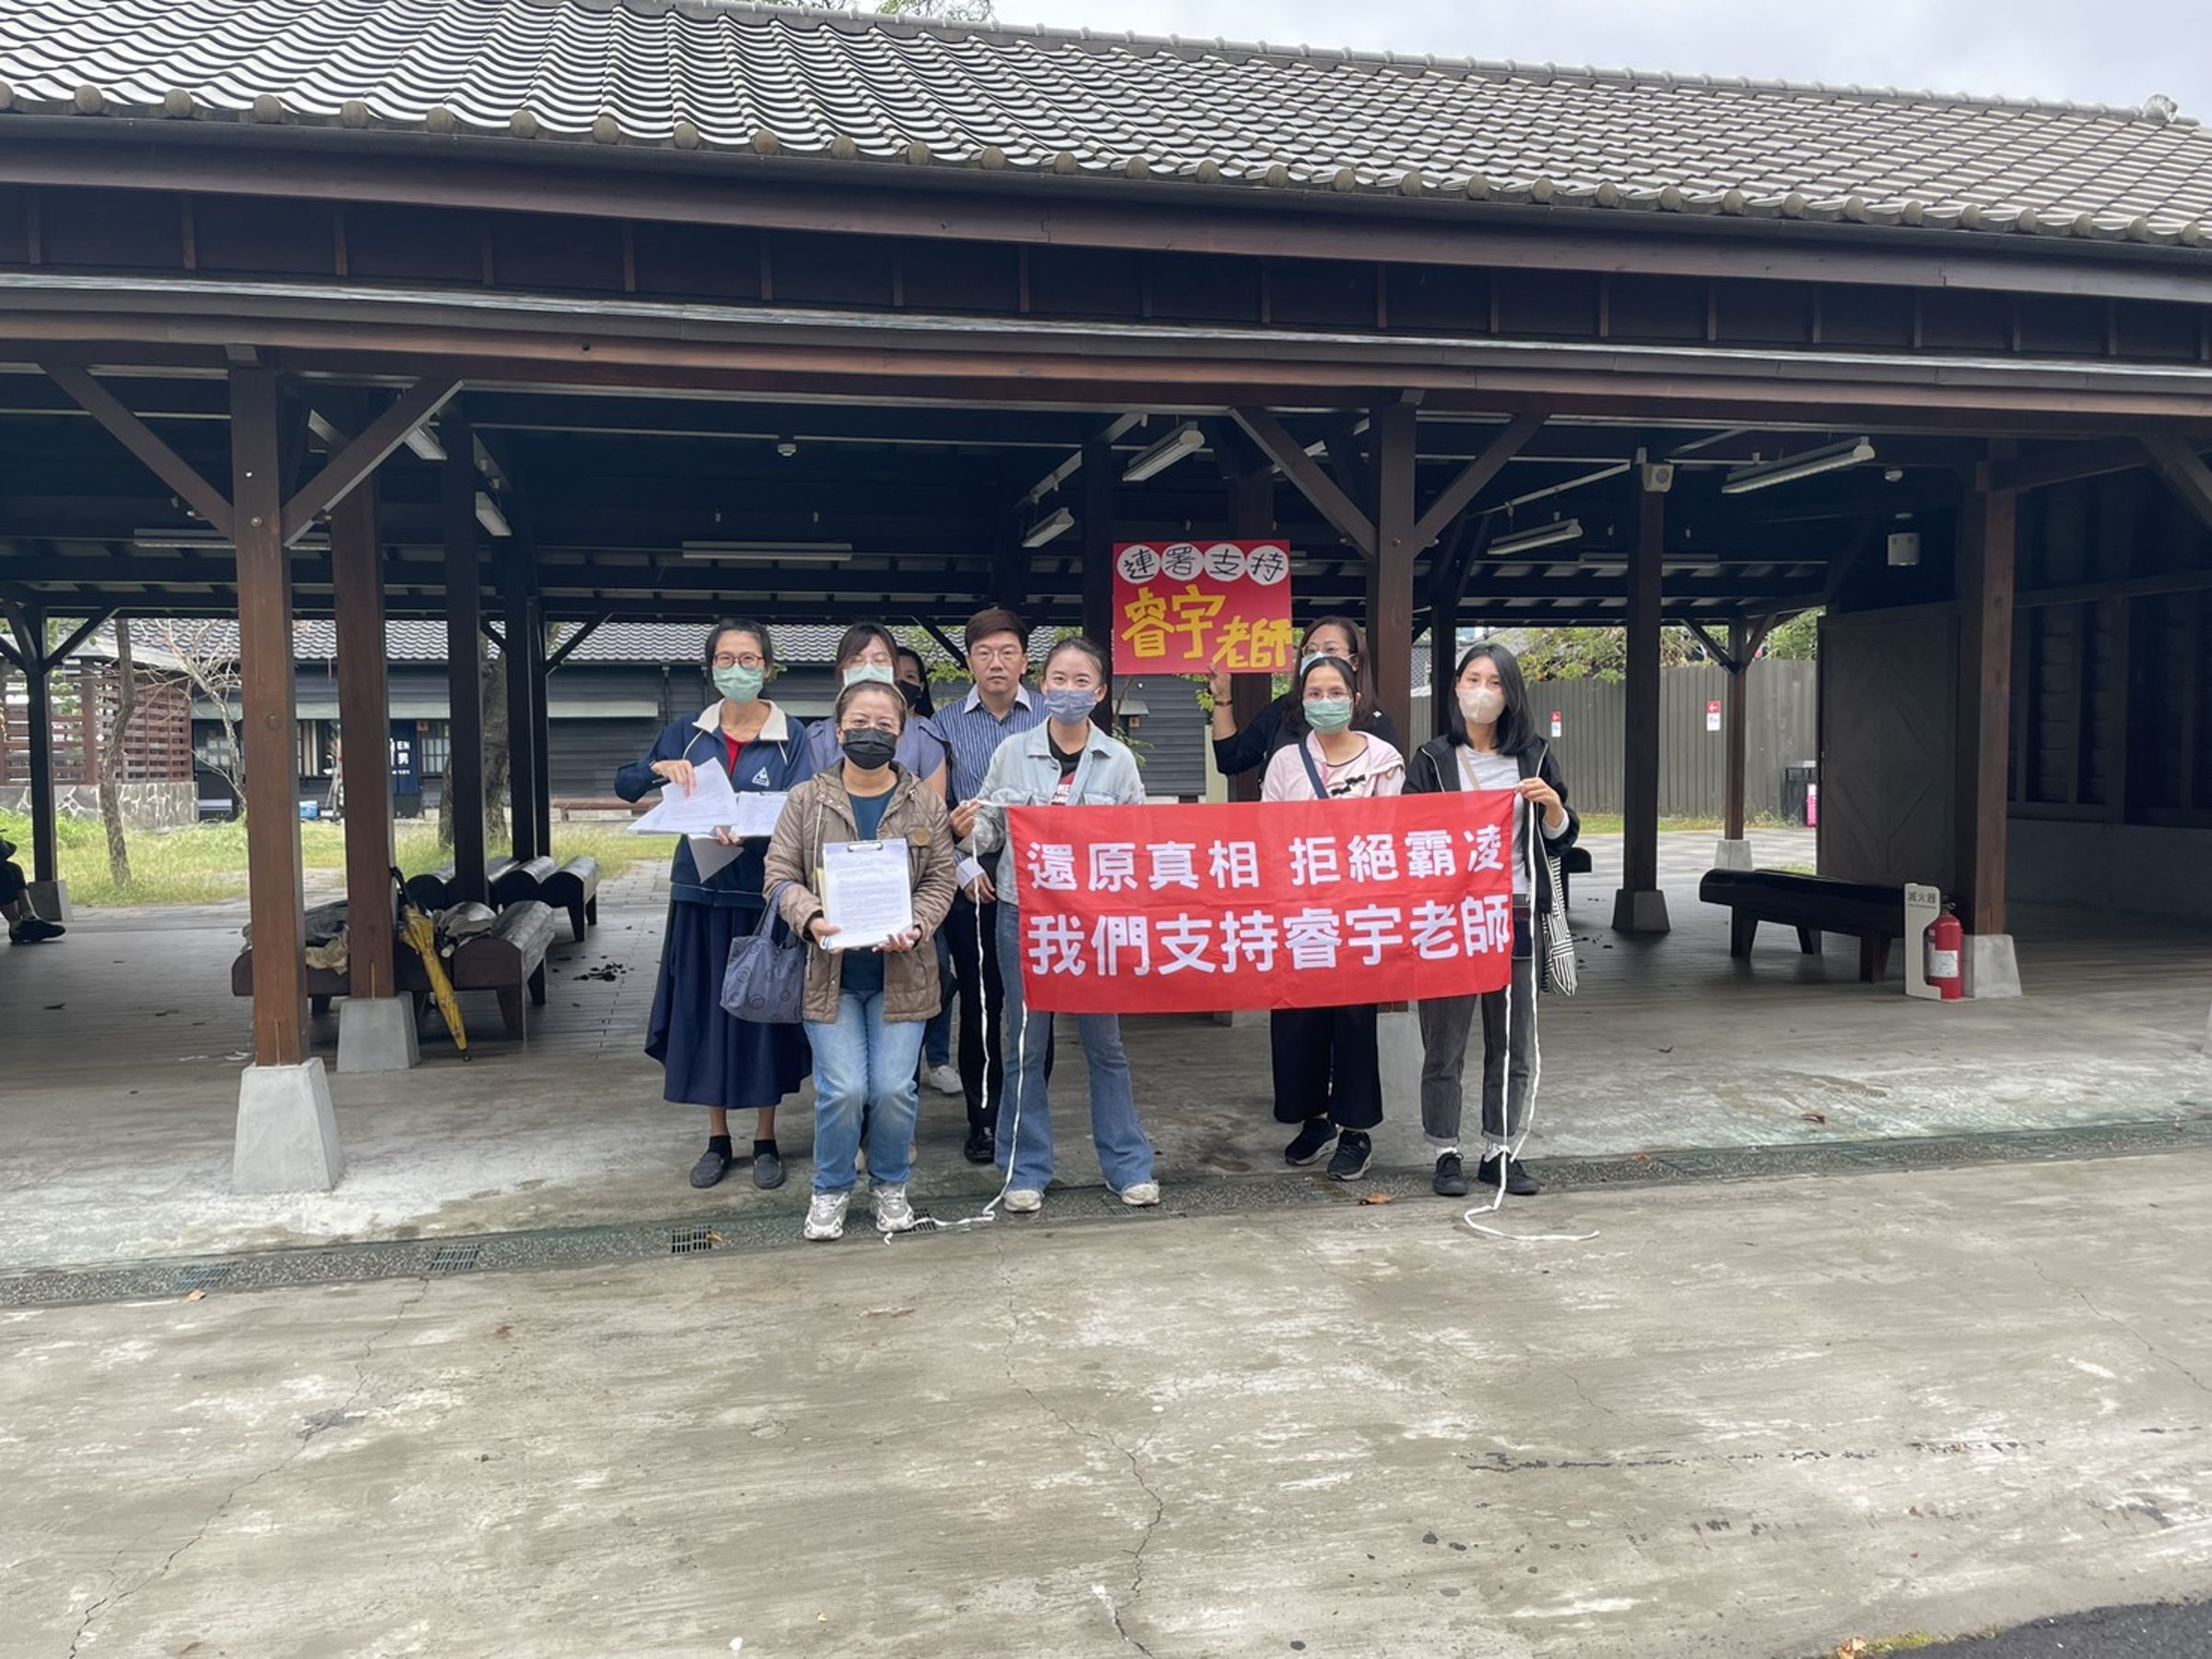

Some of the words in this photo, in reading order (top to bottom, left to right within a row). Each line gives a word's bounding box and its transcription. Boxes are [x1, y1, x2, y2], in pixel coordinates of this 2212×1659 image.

[1124, 546, 1283, 582] 連署支持
[1027, 840, 1260, 892] 還原真相
[1288, 824, 1504, 886] 拒絕霸凌
[1027, 894, 1511, 977] 我們支持睿宇老師
